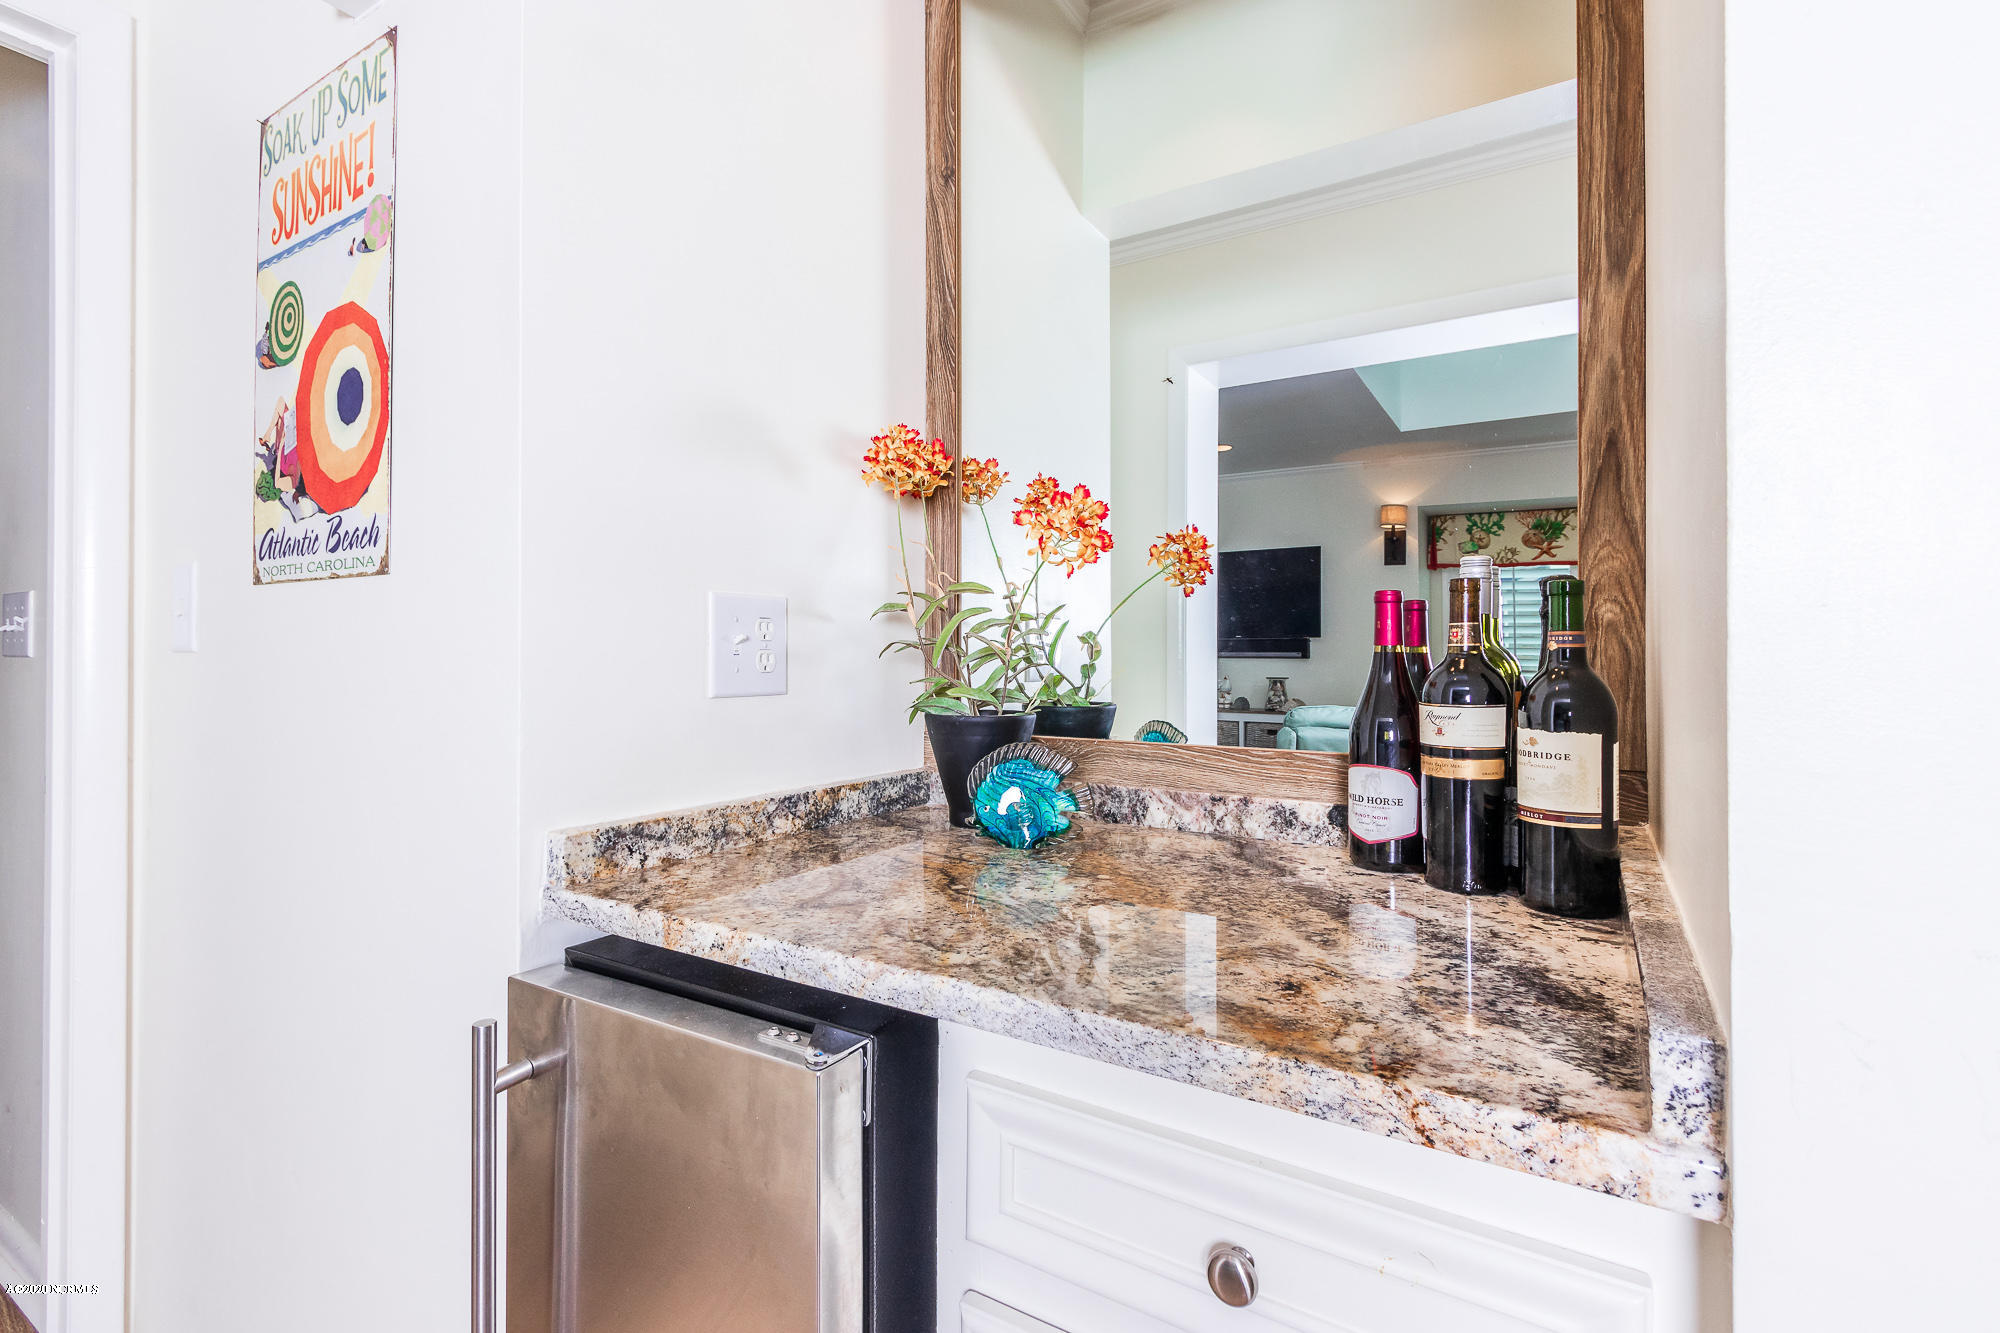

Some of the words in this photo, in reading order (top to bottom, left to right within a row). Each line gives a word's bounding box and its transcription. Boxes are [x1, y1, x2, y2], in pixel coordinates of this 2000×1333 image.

[264, 111, 306, 177] SOAK
[312, 83, 333, 146] UP
[337, 47, 390, 129] SOME
[271, 120, 375, 245] SUNSHINE!
[259, 527, 319, 561] Atlantic
[325, 512, 380, 553] Beach
[263, 562, 303, 577] NORTH
[307, 555, 376, 573] CAROLINA
[1367, 796, 1404, 807] HORSE
